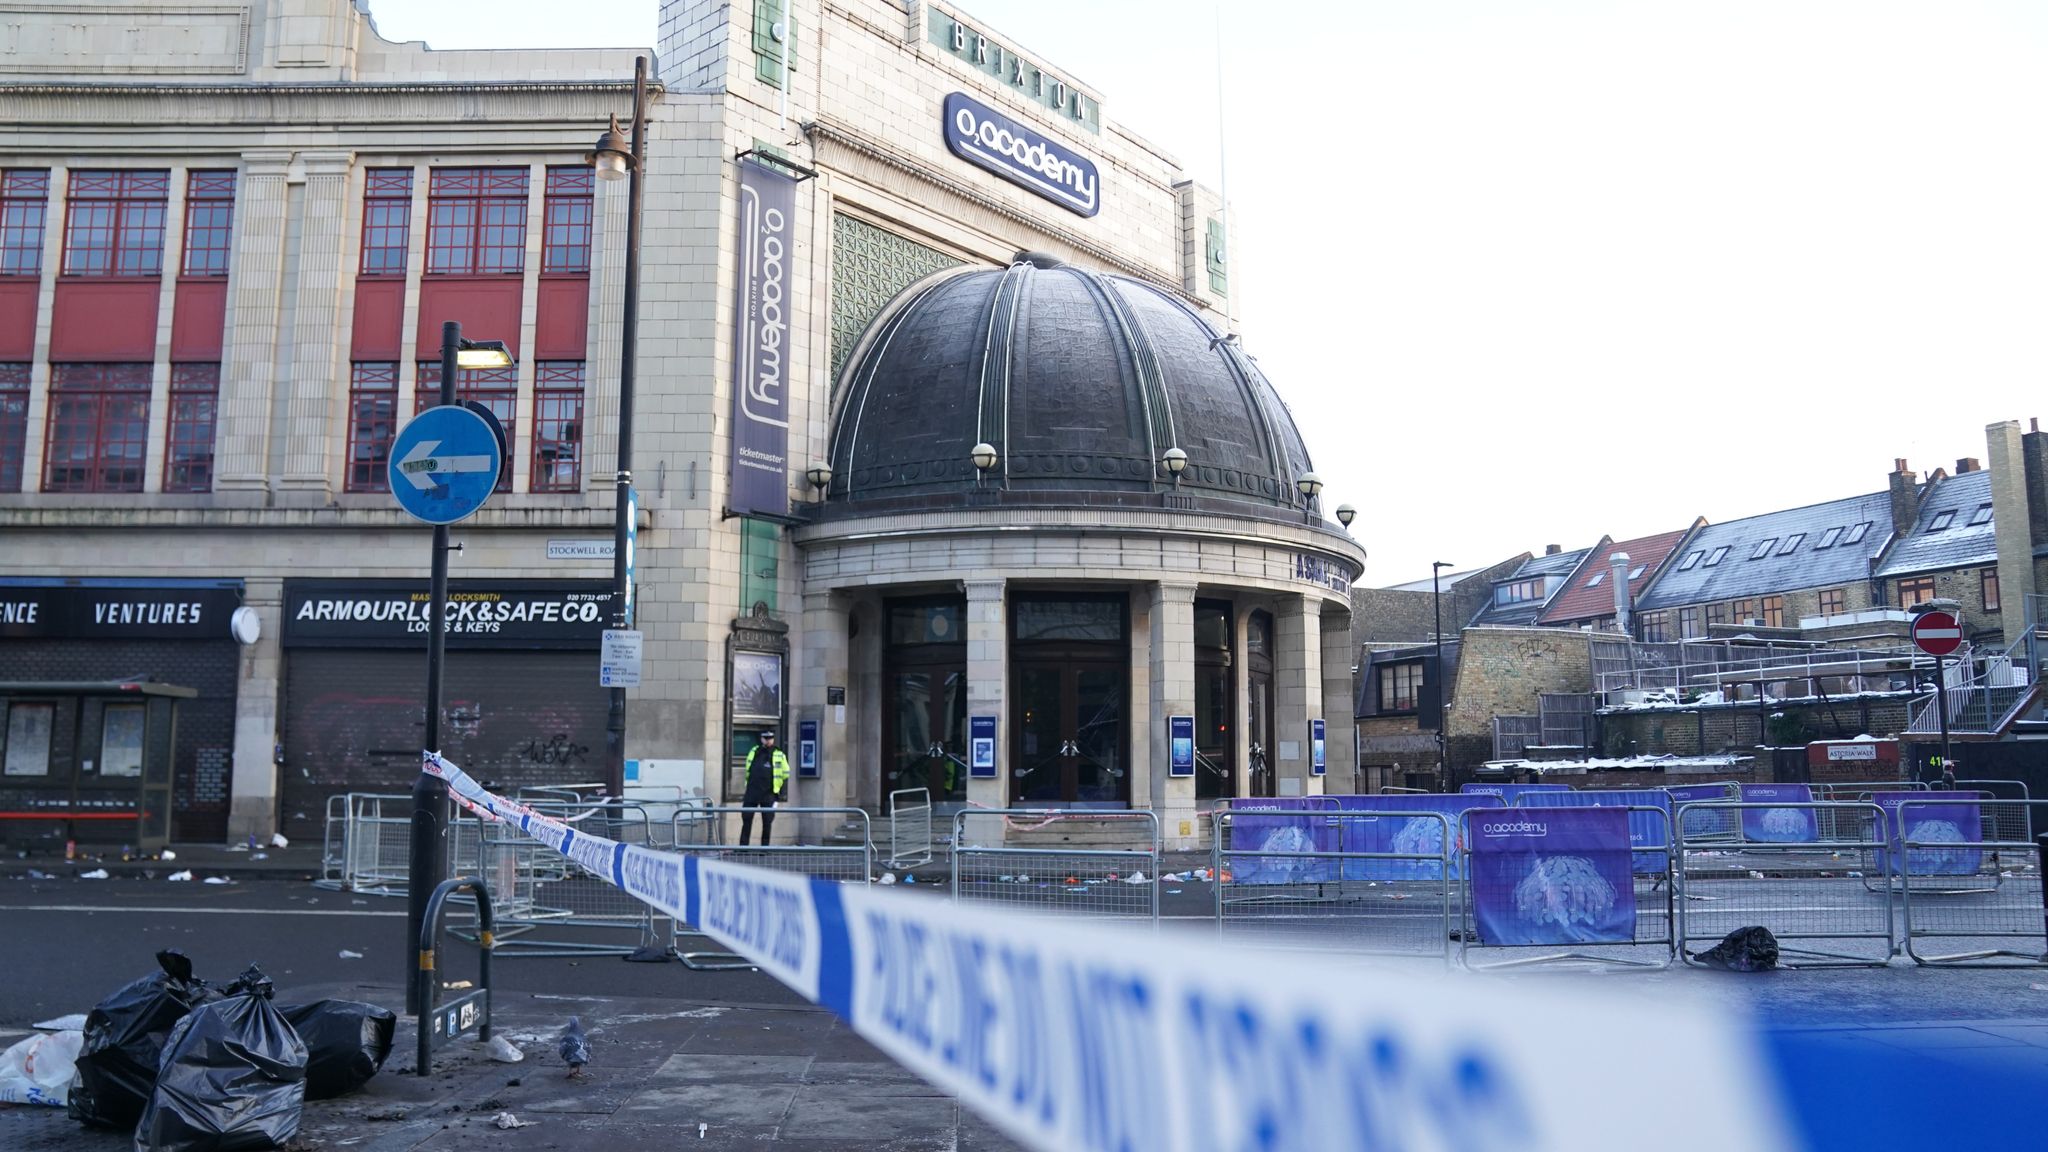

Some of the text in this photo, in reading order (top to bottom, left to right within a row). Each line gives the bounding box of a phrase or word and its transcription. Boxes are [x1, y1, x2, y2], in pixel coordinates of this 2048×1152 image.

[953, 21, 1085, 120] BRIXTON
[549, 546, 616, 555] STOCKWELL ROA
[448, 593, 501, 601] LOCKSMITH
[95, 602, 202, 624] VENTURES
[454, 622, 463, 633] &
[466, 622, 501, 633] KEYS
